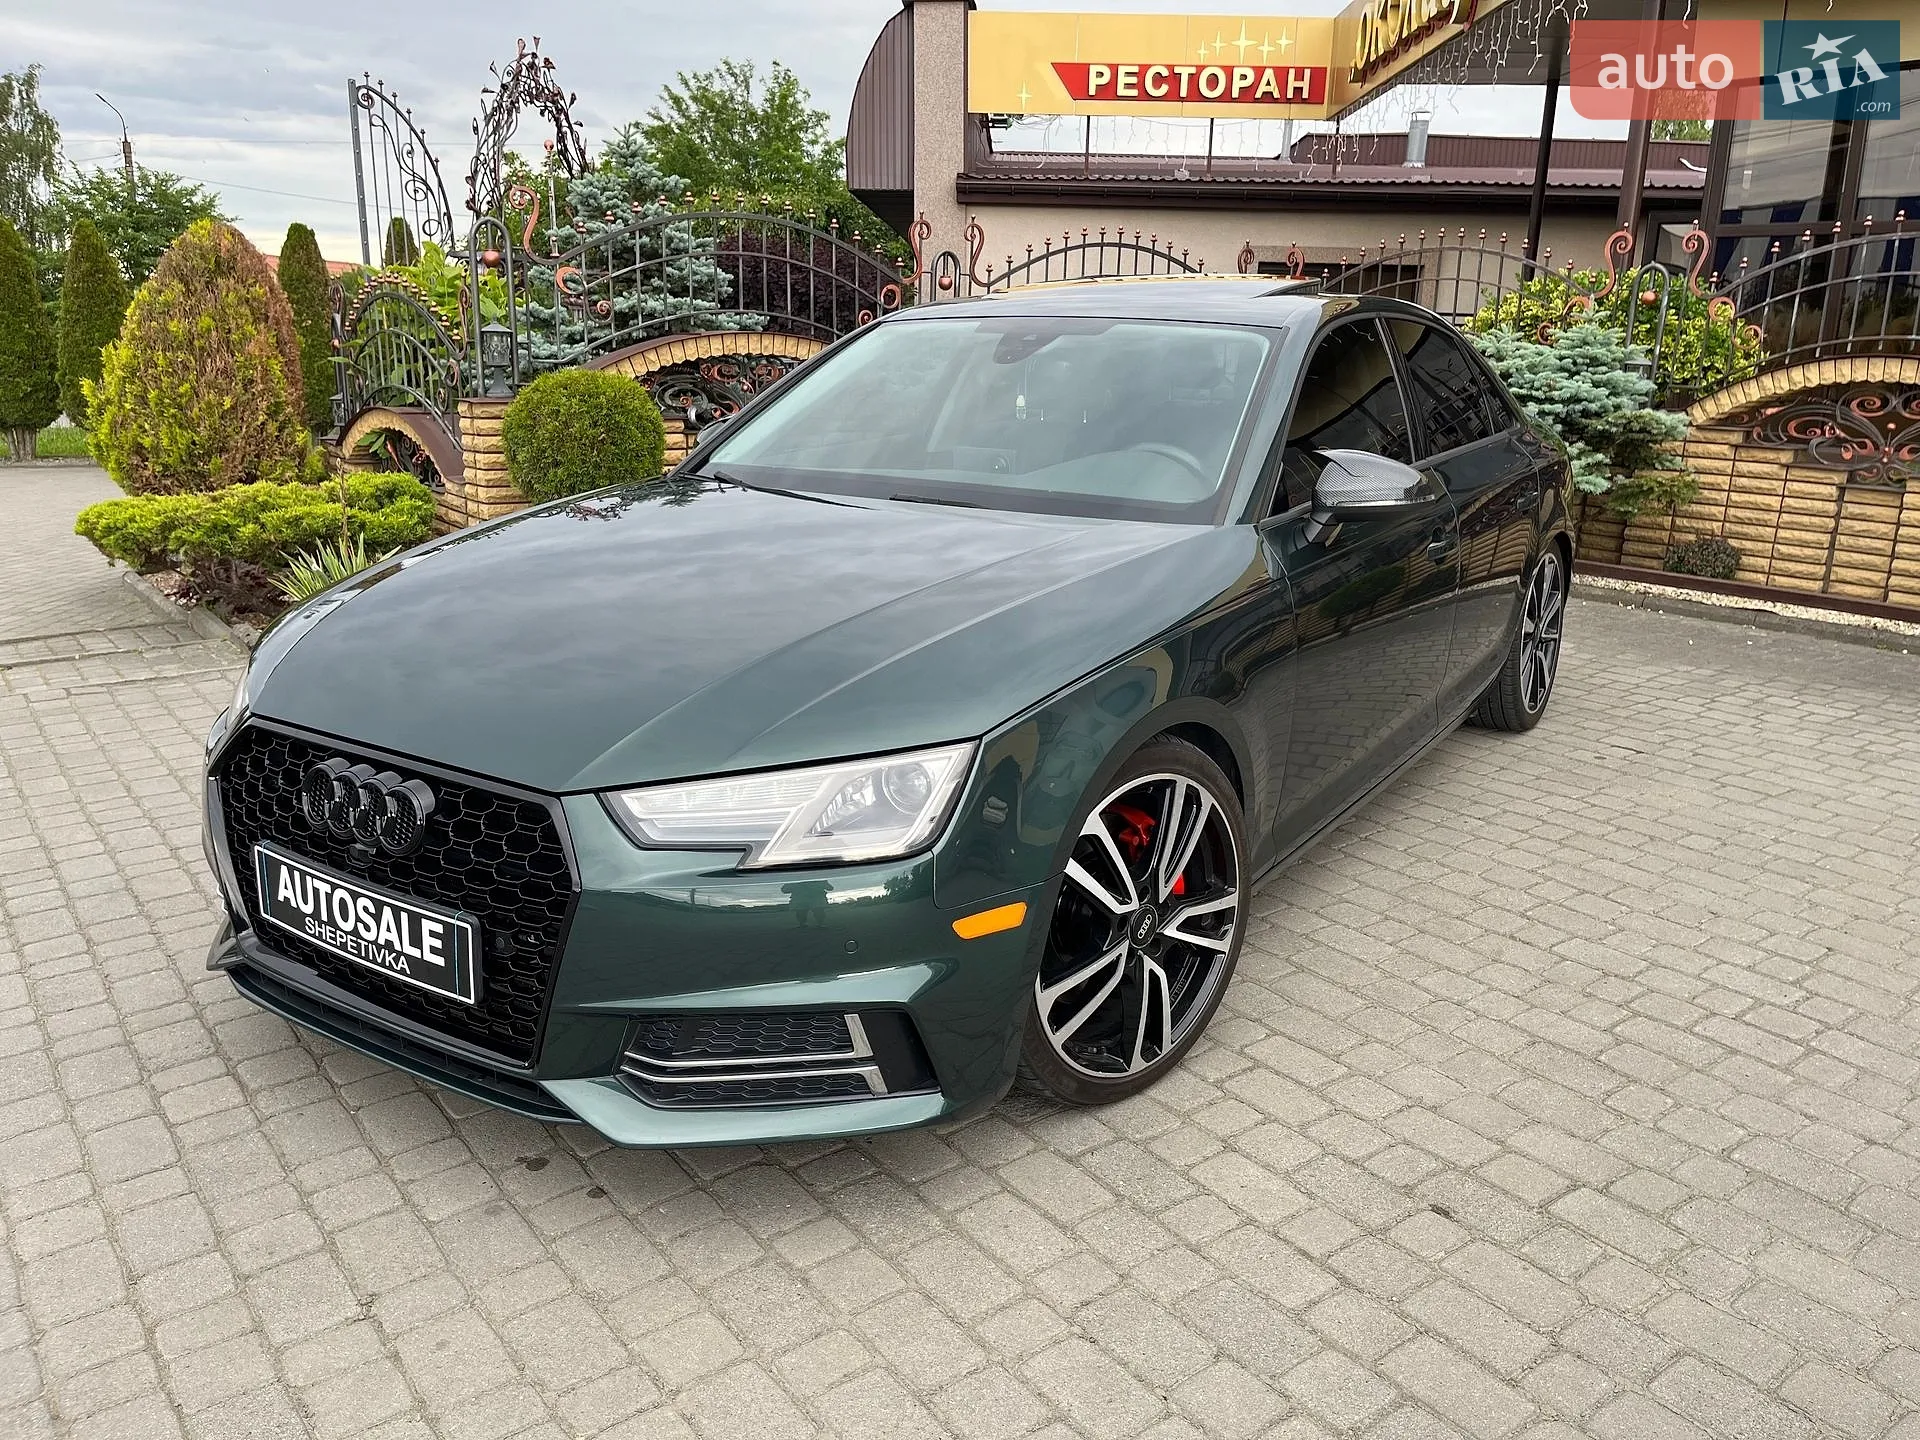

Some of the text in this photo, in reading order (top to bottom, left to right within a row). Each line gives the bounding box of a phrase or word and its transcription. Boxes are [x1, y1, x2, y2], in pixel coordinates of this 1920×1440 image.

[1087, 63, 1311, 99] РЕСТОРАН
[277, 864, 446, 968] AUTOSALE
[304, 916, 411, 975] SHEPETIVKA
